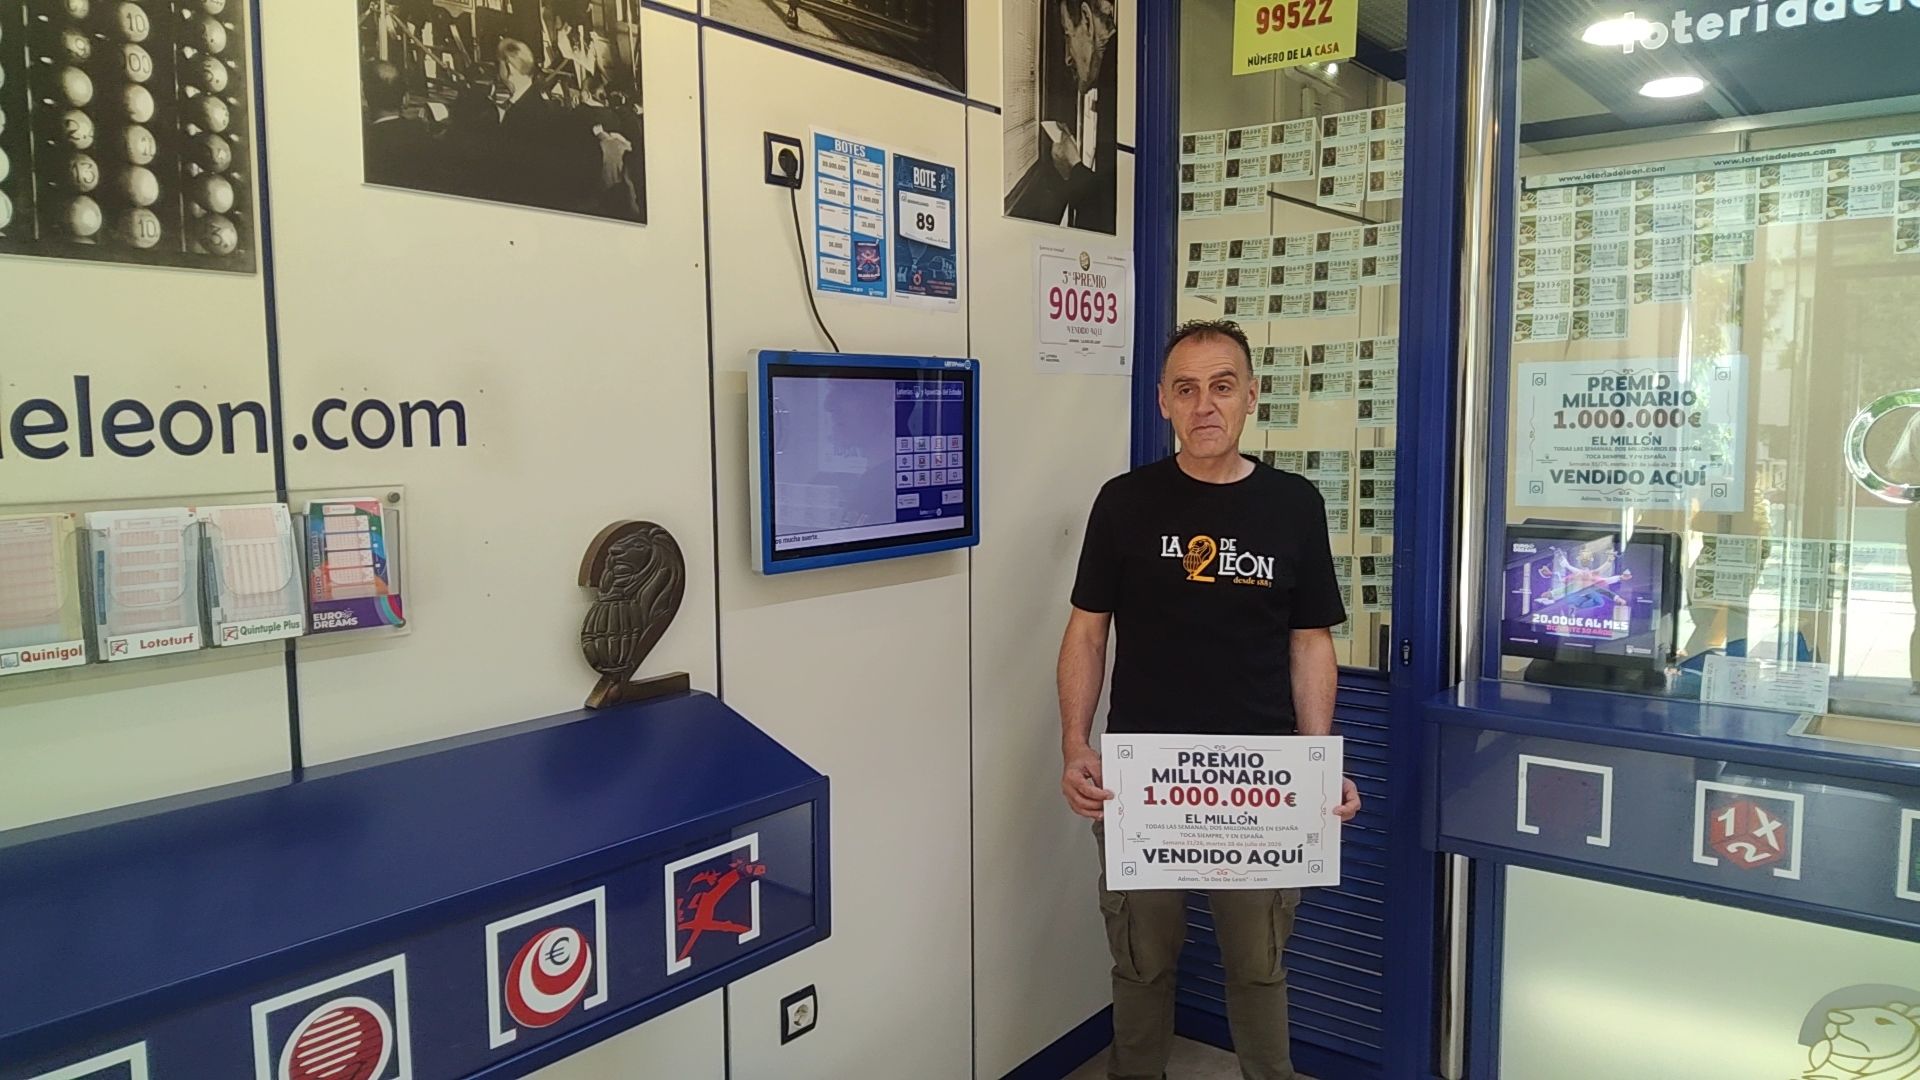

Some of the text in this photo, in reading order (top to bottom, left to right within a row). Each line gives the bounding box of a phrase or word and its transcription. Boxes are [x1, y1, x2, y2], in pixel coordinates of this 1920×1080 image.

[1256, 0, 1333, 35] 99522
[1247, 42, 1339, 67] NÚMERO DE LA CASA
[834, 139, 866, 157] BOTES
[1713, 148, 1837, 166] www.loteriadeleon.com
[913, 167, 937, 188] BOTE
[1558, 165, 1666, 182] www.loteriadeleon.com
[916, 212, 935, 232] 89
[1073, 272, 1107, 289] PREMIO
[1048, 286, 1118, 325] 90693
[1587, 375, 1671, 391] PREMIO
[1562, 390, 1697, 408] MILLONARIO
[0, 375, 468, 460] eleon.com
[1553, 408, 1702, 429] 1.000.000€
[1591, 432, 1662, 446] EL MILLÓN
[1550, 465, 1707, 488] VENDIDO AQUÍ
[1161, 535, 1237, 583] LA 2 DE
[1218, 551, 1275, 579] LEÓN
[313, 611, 342, 622] EURO
[313, 617, 359, 630] DREAMS
[1585, 619, 1602, 628] AL
[1603, 620, 1629, 631] MES
[239, 619, 300, 636] Quintuple Plus
[140, 633, 194, 650] Lototurf
[20, 645, 83, 663] Quinigol
[1177, 751, 1264, 768] PREMIO
[1151, 768, 1292, 785] MILLONARIO
[1143, 785, 1297, 808] 1.000.000€
[1185, 810, 1258, 825] EL MILLÓN
[1142, 843, 1304, 867] VENDIDO AQUÍ
